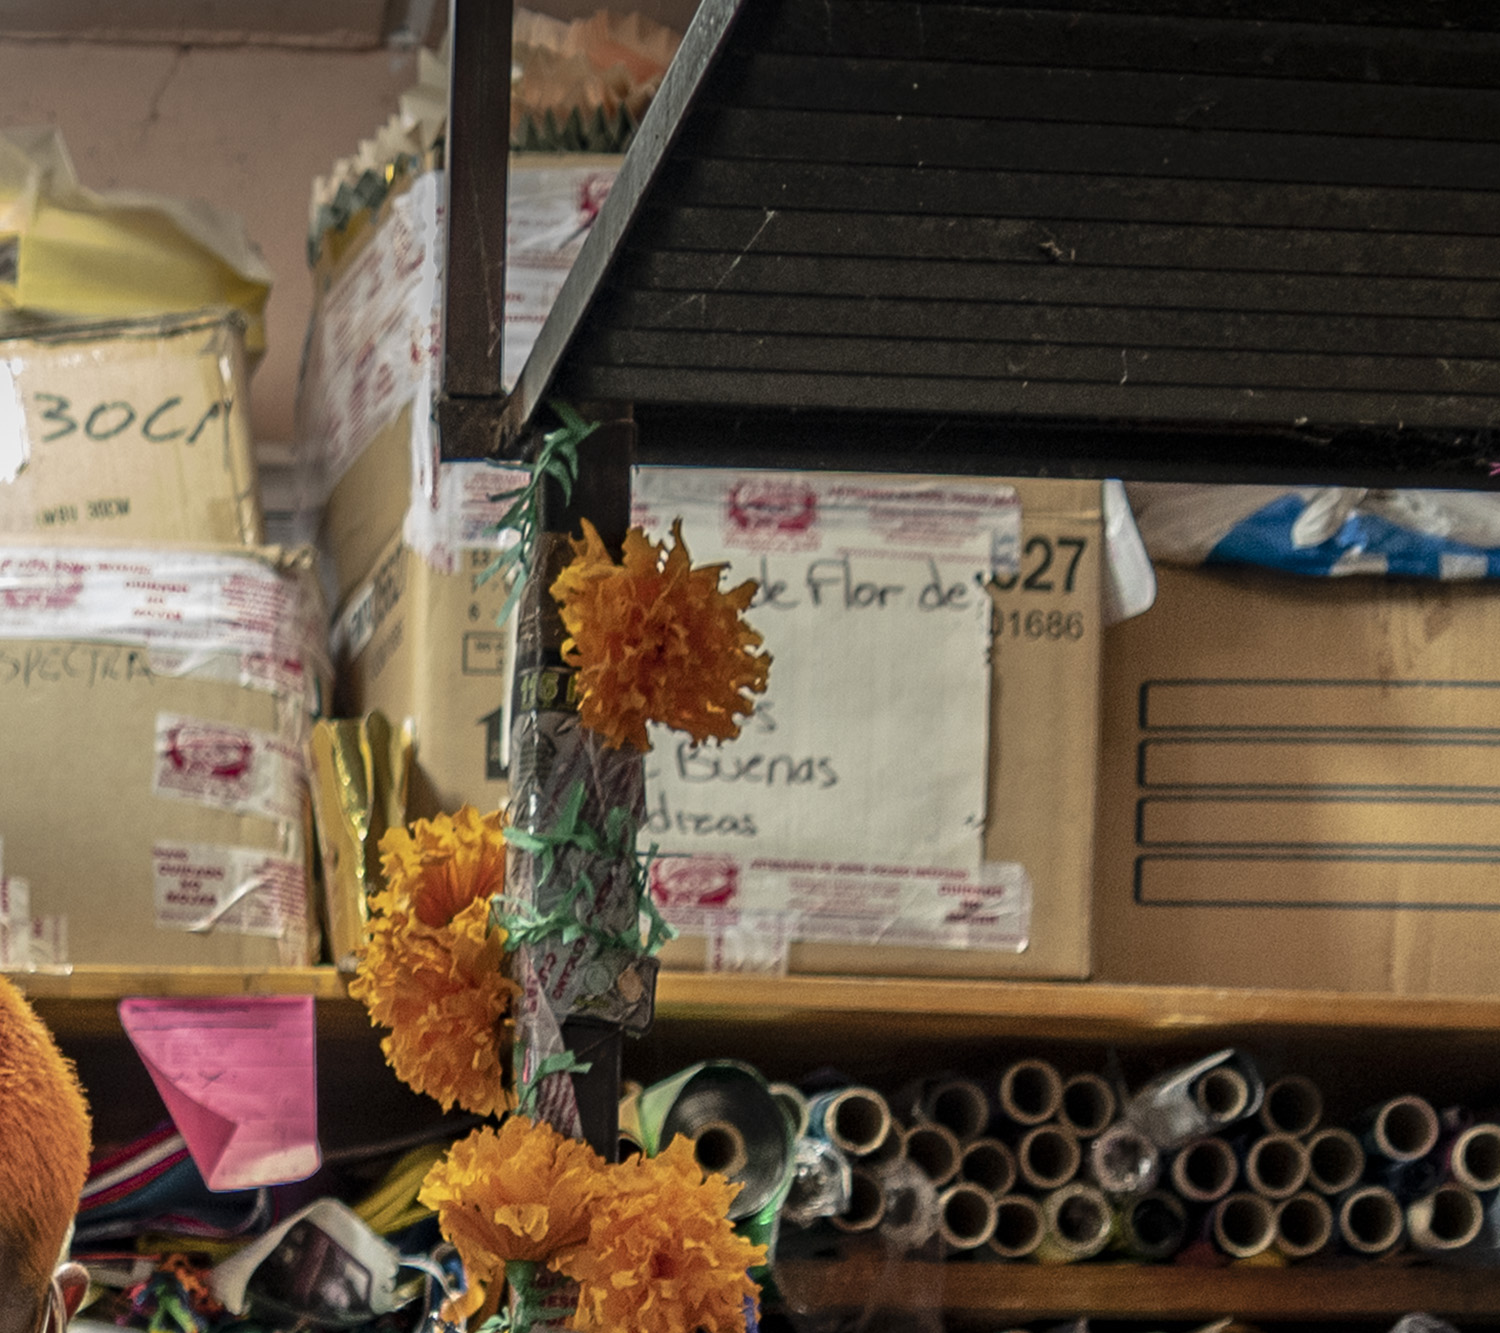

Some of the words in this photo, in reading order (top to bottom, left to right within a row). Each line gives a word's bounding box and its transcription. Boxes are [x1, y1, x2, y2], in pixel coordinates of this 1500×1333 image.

[806, 553, 903, 611] Flor
[917, 555, 970, 612] de
[674, 740, 839, 788] Buenas
